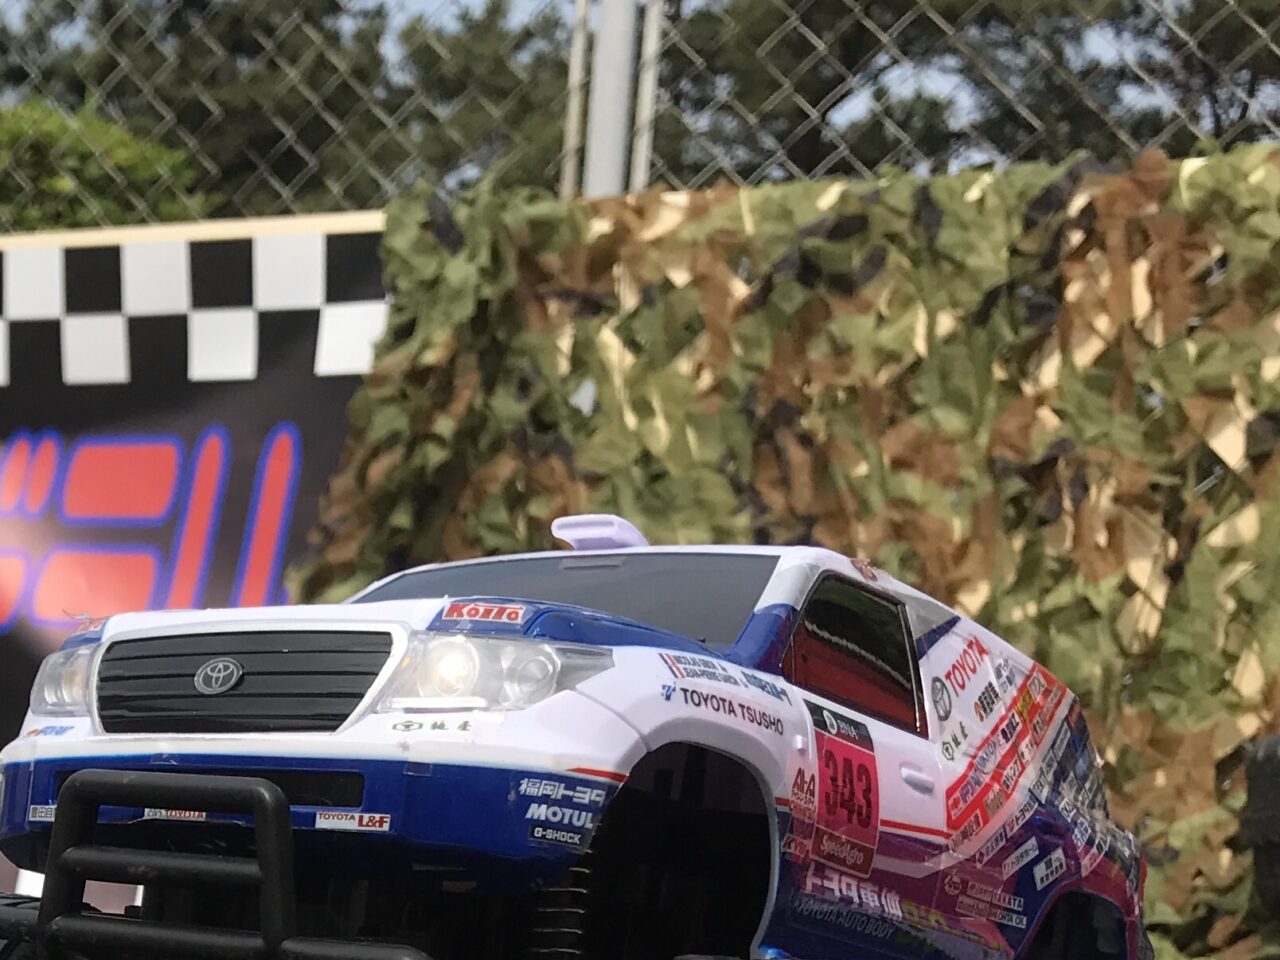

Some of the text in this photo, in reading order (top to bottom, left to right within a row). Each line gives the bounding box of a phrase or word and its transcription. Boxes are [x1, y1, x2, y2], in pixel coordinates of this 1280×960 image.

[945, 635, 990, 698] TOYOTA
[680, 687, 737, 717] TOYOTA
[738, 703, 784, 735] TSUSHO
[518, 778, 606, 806] 福岡トヨタ
[824, 749, 872, 829] 343
[319, 812, 390, 829] TOYOTA L&F
[525, 803, 594, 829] MOTUL
[534, 827, 581, 844] G-SHOCK
[838, 911, 867, 931] AUTO
[865, 917, 896, 939] BODY
